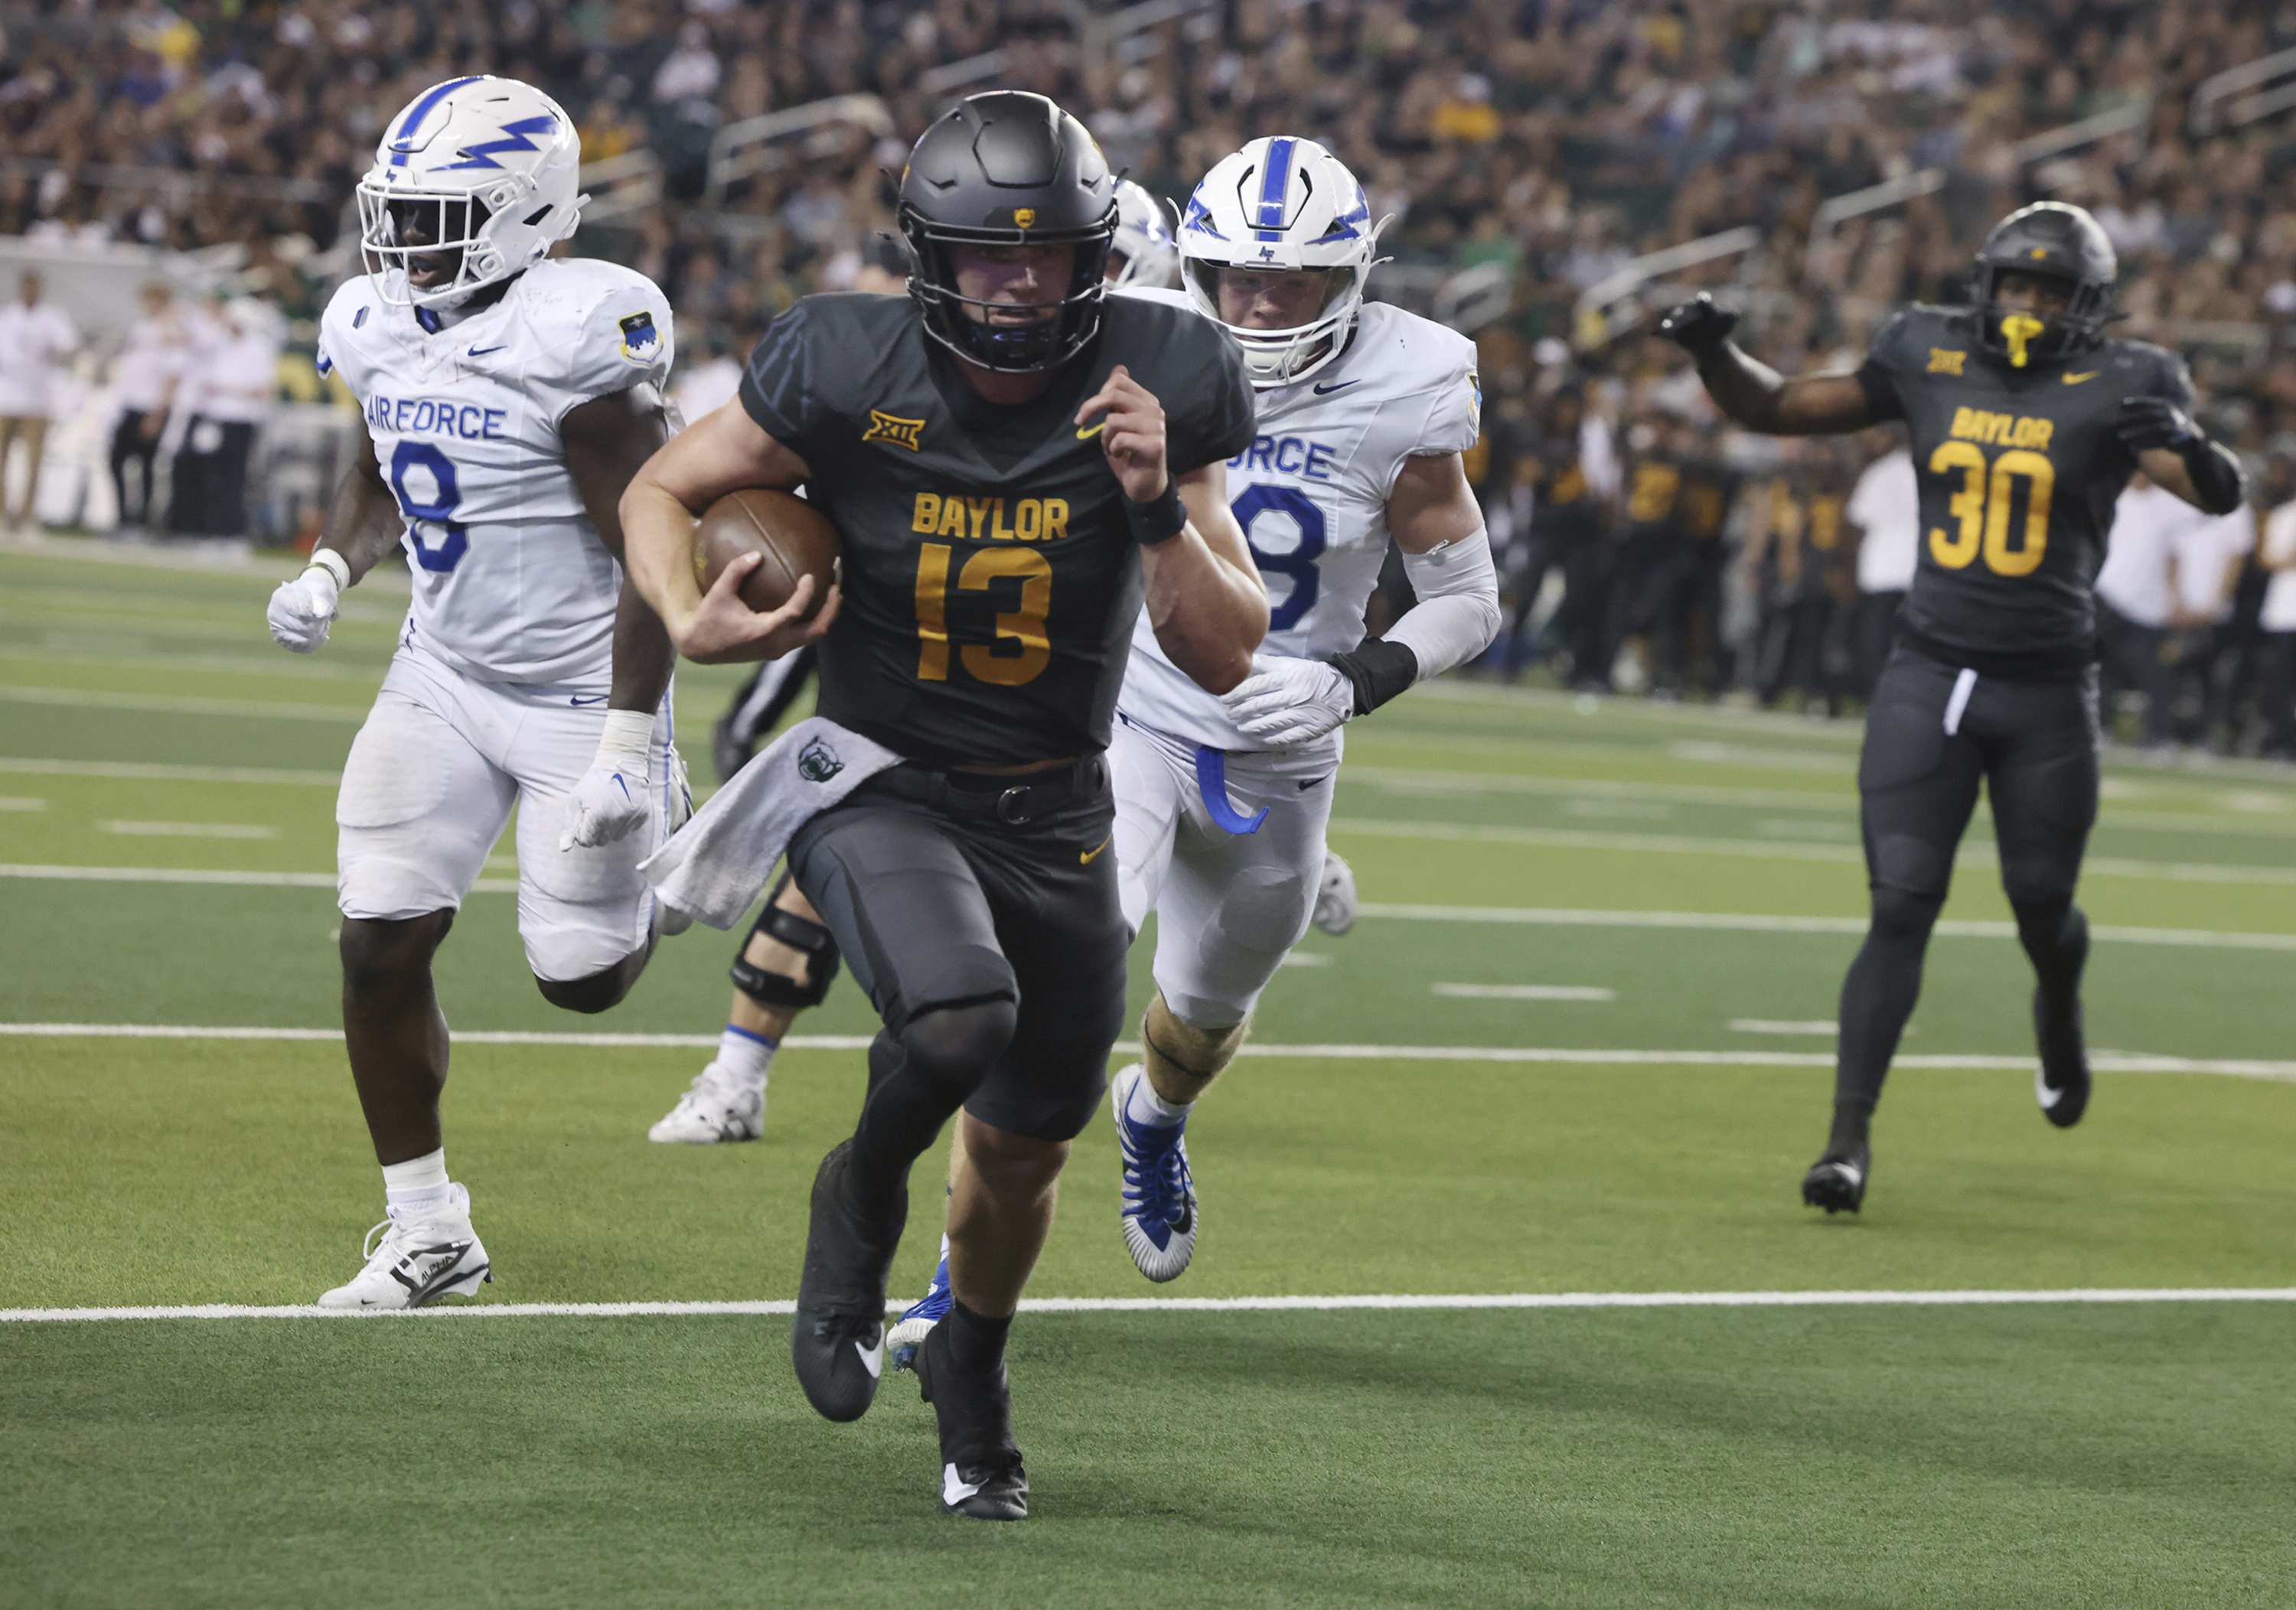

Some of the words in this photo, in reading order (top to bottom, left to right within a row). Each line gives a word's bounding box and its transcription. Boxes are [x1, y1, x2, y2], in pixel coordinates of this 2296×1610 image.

[368, 394, 392, 432] AIR
[396, 399, 506, 440] FORCE
[1950, 406, 2054, 451] BAYLOR
[391, 438, 471, 573] 8
[912, 491, 1070, 540] BAYLOR
[1928, 439, 2055, 577] 30
[915, 542, 1052, 686] 13
